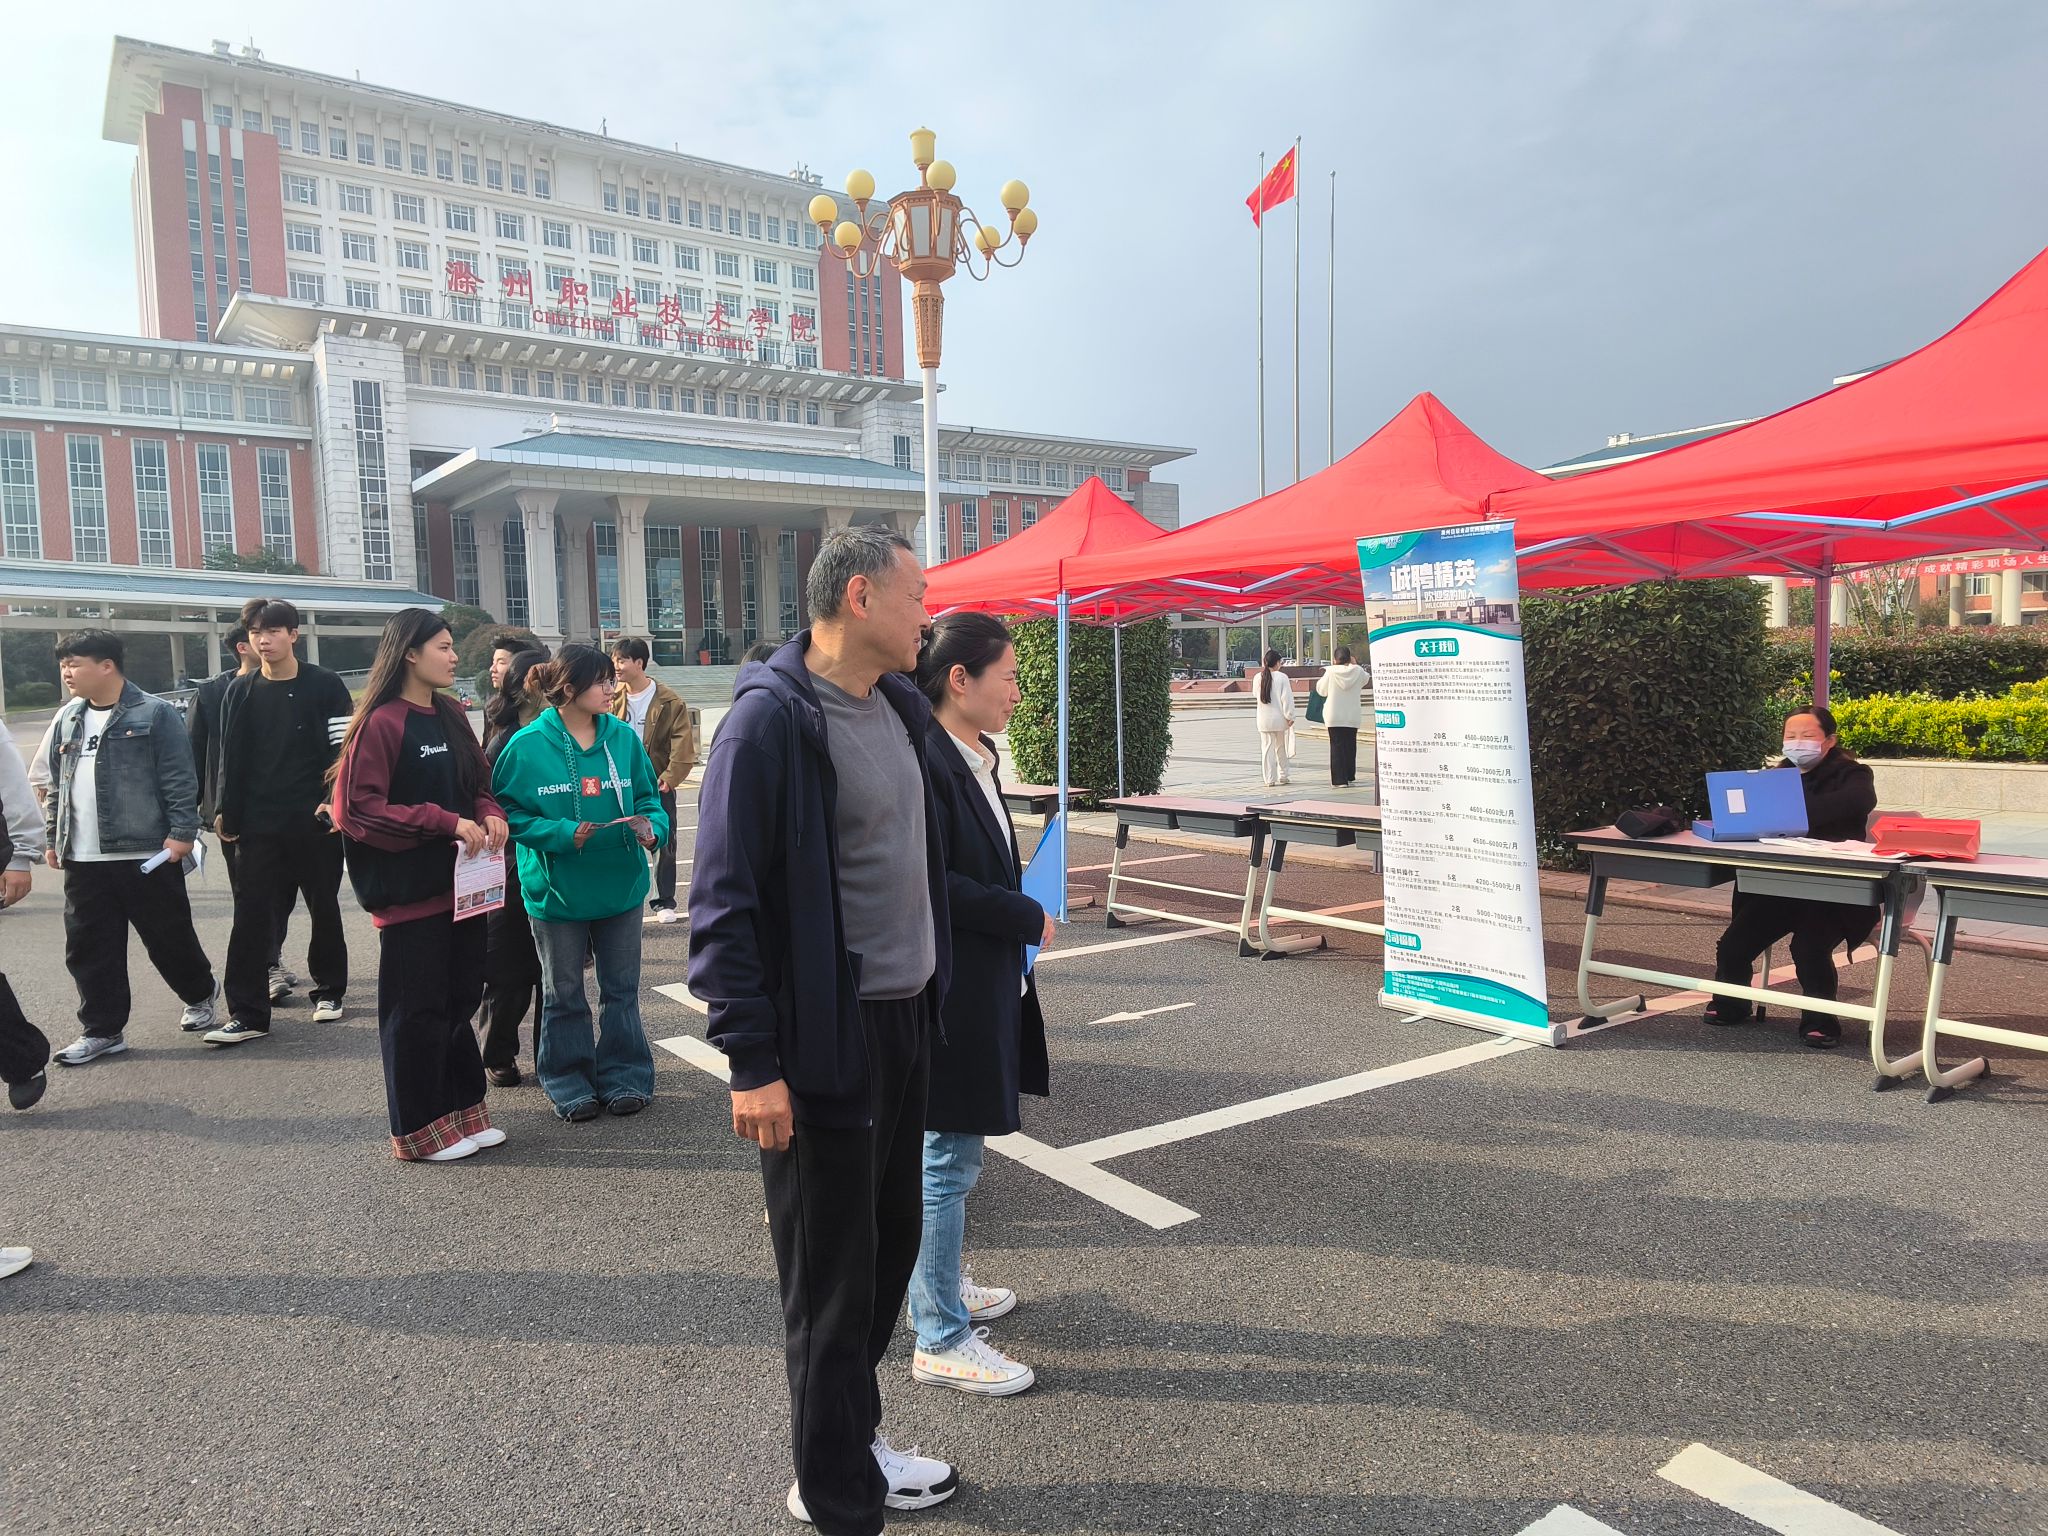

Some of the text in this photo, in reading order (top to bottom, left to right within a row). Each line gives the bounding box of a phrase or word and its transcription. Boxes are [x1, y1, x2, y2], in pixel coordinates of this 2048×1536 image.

[445, 261, 817, 342] 滁州职业技术学院
[533, 309, 754, 351] CHUZHOU POLYTECHNIC
[1390, 558, 1476, 598] 诚聘精英
[1419, 640, 1456, 653] 关于我们
[1433, 732, 1447, 740] 20名
[537, 782, 580, 796] FASHIO
[1441, 803, 1451, 811] 5名
[1444, 834, 1454, 842] 5名
[1447, 873, 1457, 882] 5名
[1451, 905, 1461, 913] 2名
